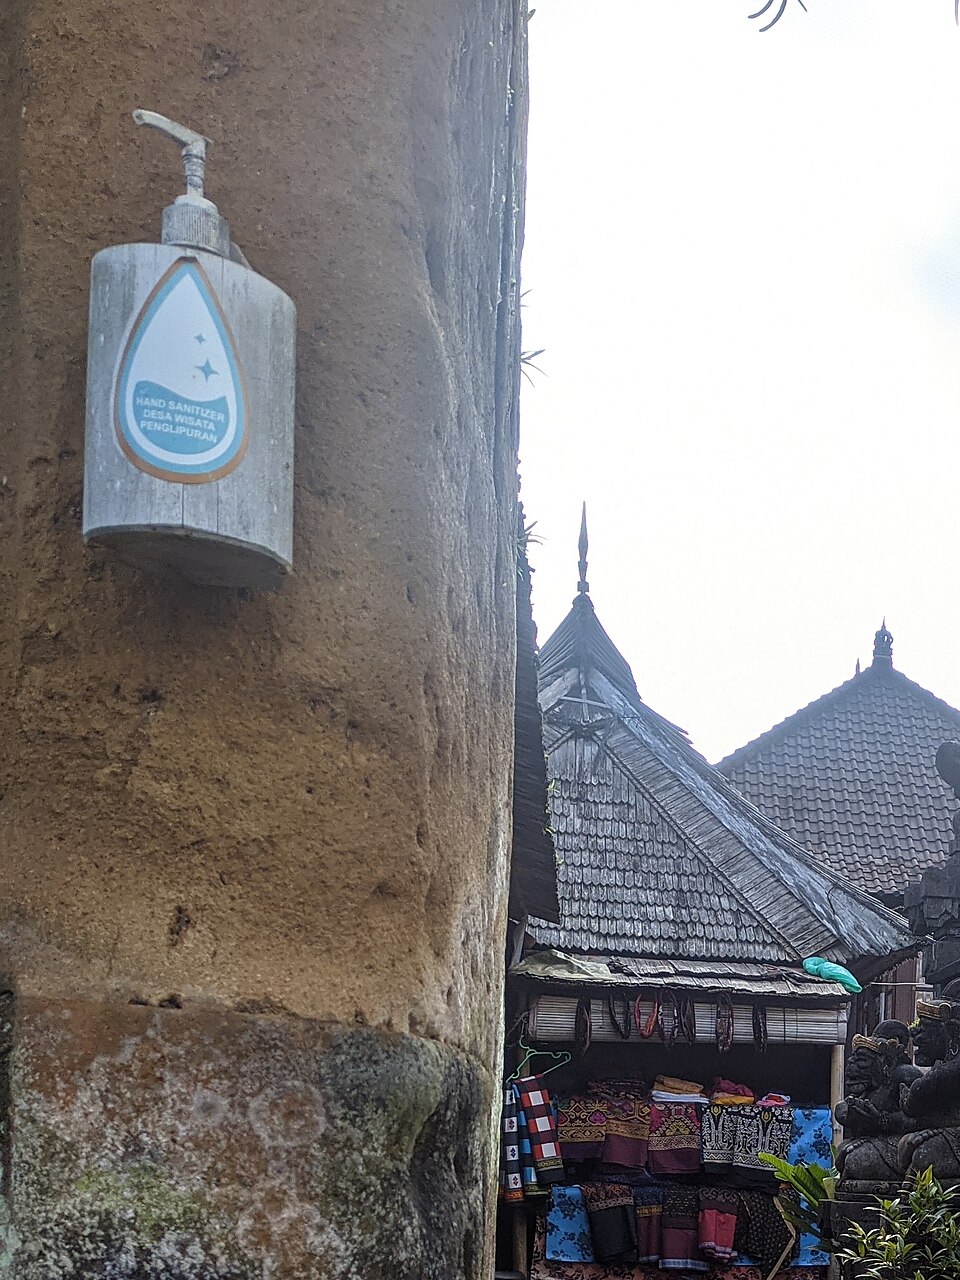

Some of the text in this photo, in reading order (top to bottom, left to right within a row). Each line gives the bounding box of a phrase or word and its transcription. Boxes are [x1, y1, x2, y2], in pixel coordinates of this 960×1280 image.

[136, 397, 225, 422] HAND SANITIZER
[143, 409, 216, 431] DESA WISATA
[140, 420, 217, 444] PENGLIPURAN
